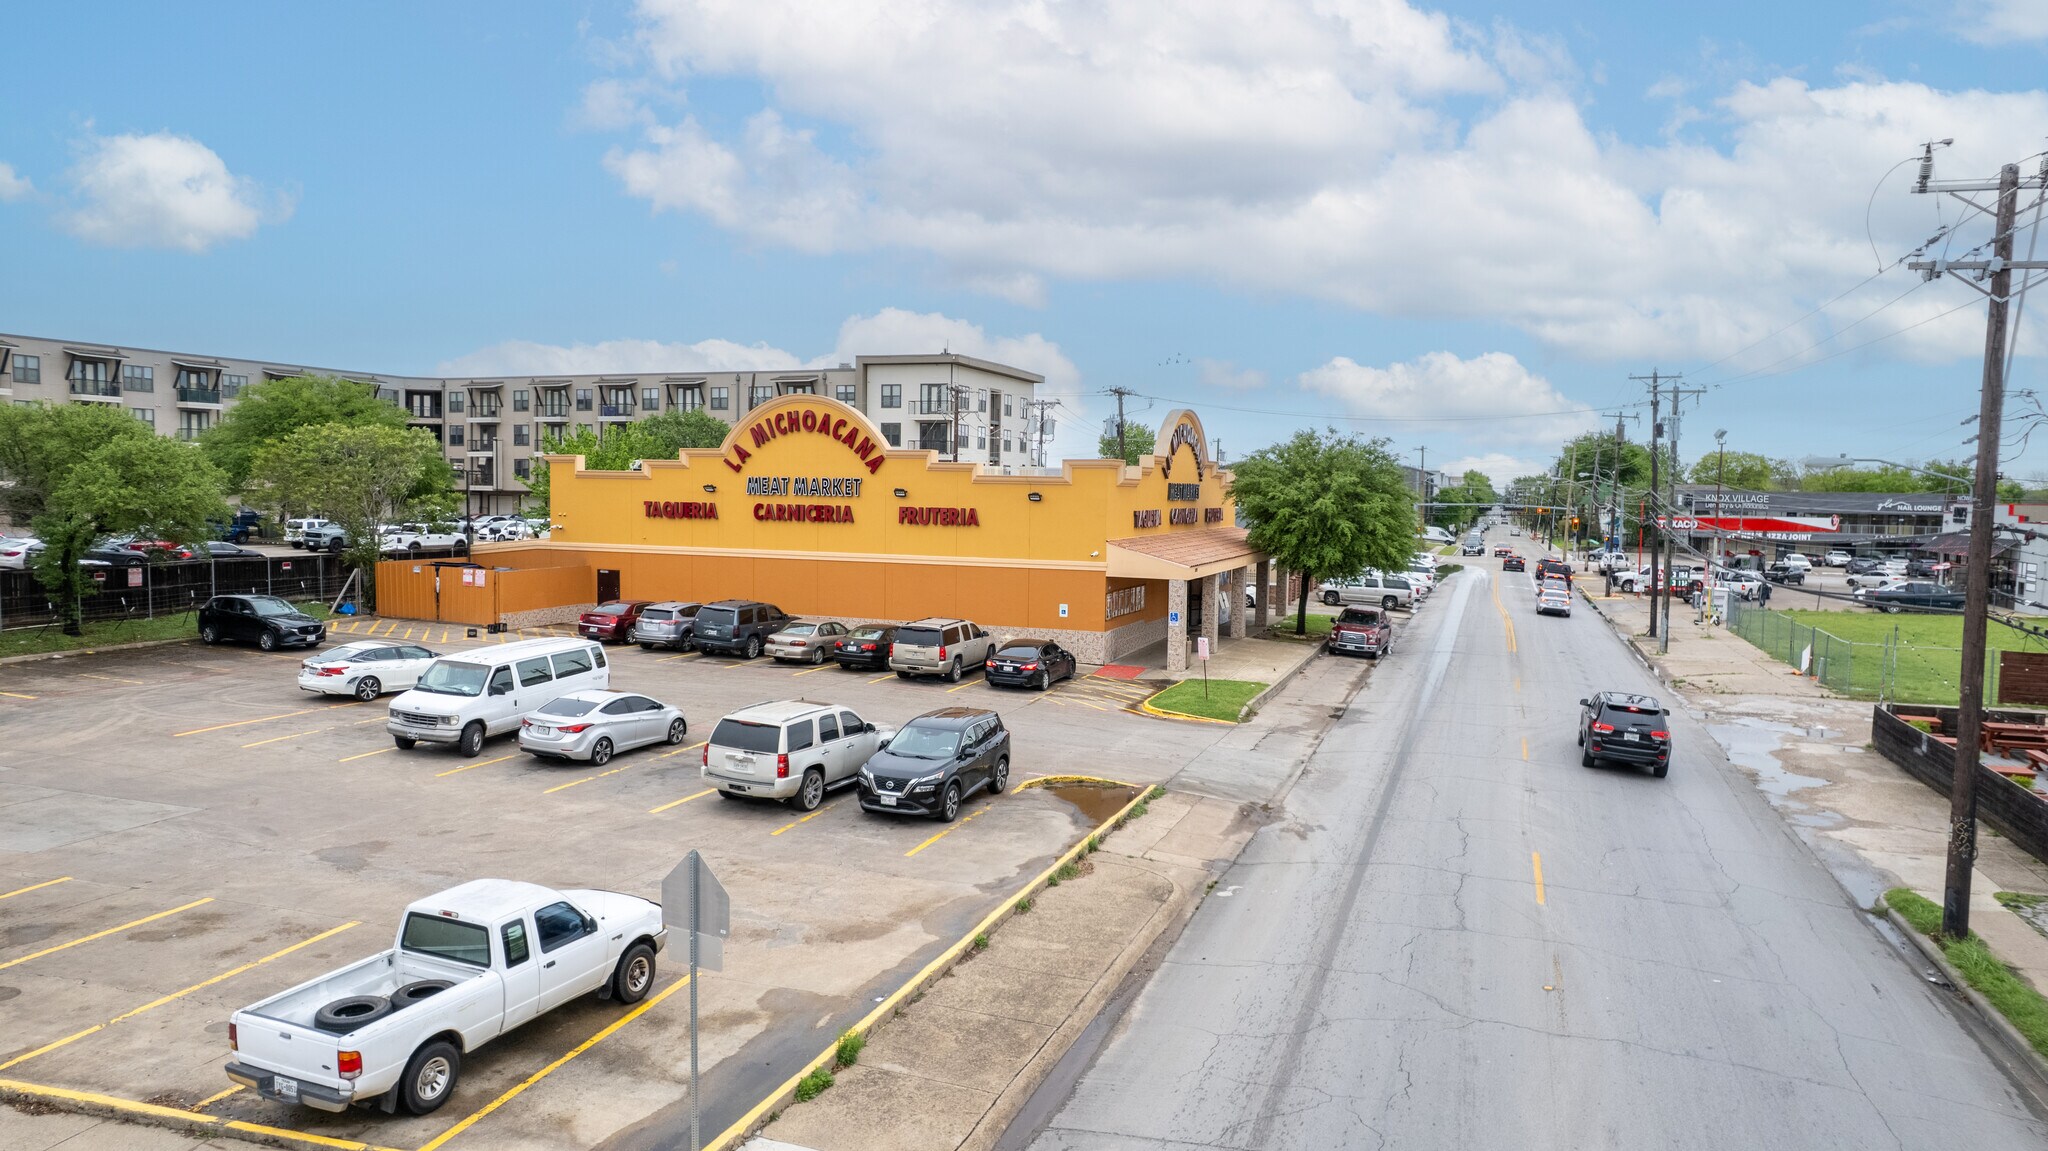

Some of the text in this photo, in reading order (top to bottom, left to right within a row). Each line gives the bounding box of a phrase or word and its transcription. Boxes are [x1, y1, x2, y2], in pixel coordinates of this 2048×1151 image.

[723, 410, 886, 475] LA MICHOACANA
[746, 476, 862, 497] MEAT MARKET
[1705, 494, 1769, 504] KNOX VILLAGE
[644, 501, 718, 520] TAQUERIA
[753, 503, 854, 523] CARNICERIA
[898, 507, 979, 526] FRUTERIA
[1658, 520, 1699, 529] TXACO
[1789, 533, 1812, 541] JOINT
